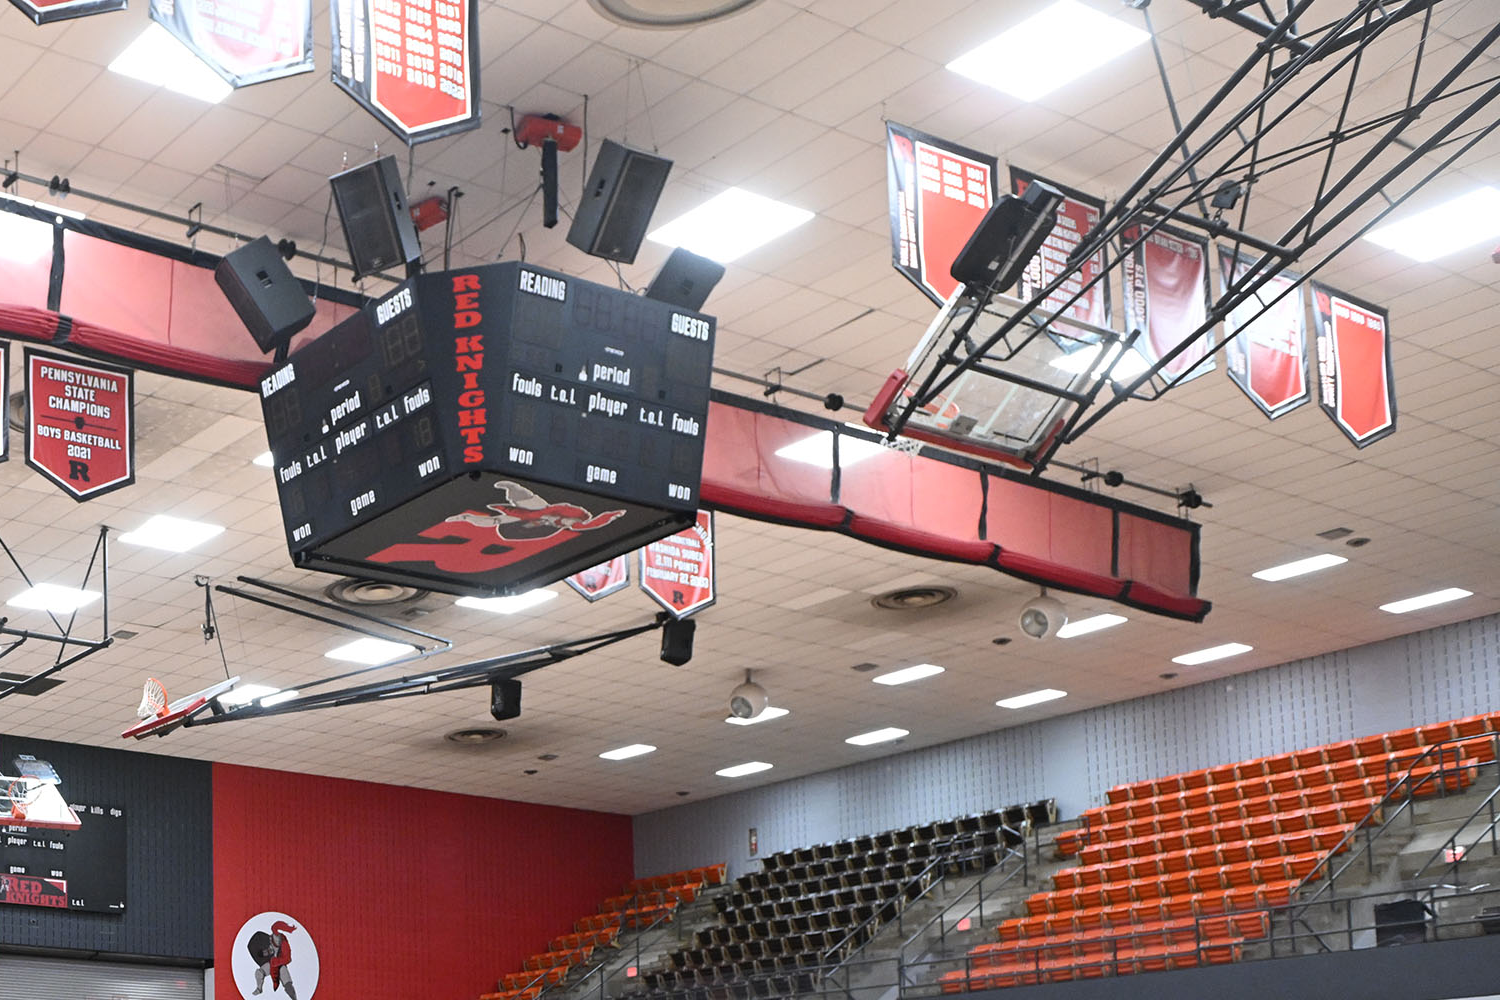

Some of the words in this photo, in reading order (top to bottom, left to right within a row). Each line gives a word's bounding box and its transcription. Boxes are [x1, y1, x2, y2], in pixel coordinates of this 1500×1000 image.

[376, 287, 413, 325] GUESTS
[452, 274, 482, 329] RED
[519, 269, 567, 302] READING
[671, 312, 710, 342] GUESTS
[40, 366, 118, 393] PENNSYLVANIA
[260, 363, 296, 398] READING
[592, 363, 631, 387] period
[48, 396, 111, 419] CHAMPIONS
[64, 386, 96, 402] STATE
[455, 334, 487, 464] KNIGHTS
[512, 372, 542, 398] fouls
[588, 391, 628, 417] player
[672, 412, 699, 436] fouls
[330, 390, 361, 427] period
[37, 425, 62, 439] BOYS
[64, 430, 122, 450] BASKETBALL
[280, 461, 302, 483] fouls
[335, 421, 367, 454] player
[404, 387, 431, 415] fouls
[67, 444, 92, 460] 2021
[69, 460, 90, 482] R
[418, 455, 441, 477] won
[509, 447, 534, 466] won
[586, 464, 617, 485] game
[668, 483, 691, 501] won
[350, 489, 376, 517] game
[293, 522, 313, 543] won
[7, 876, 43, 894] RED
[6, 892, 66, 906] KNIGHTS
